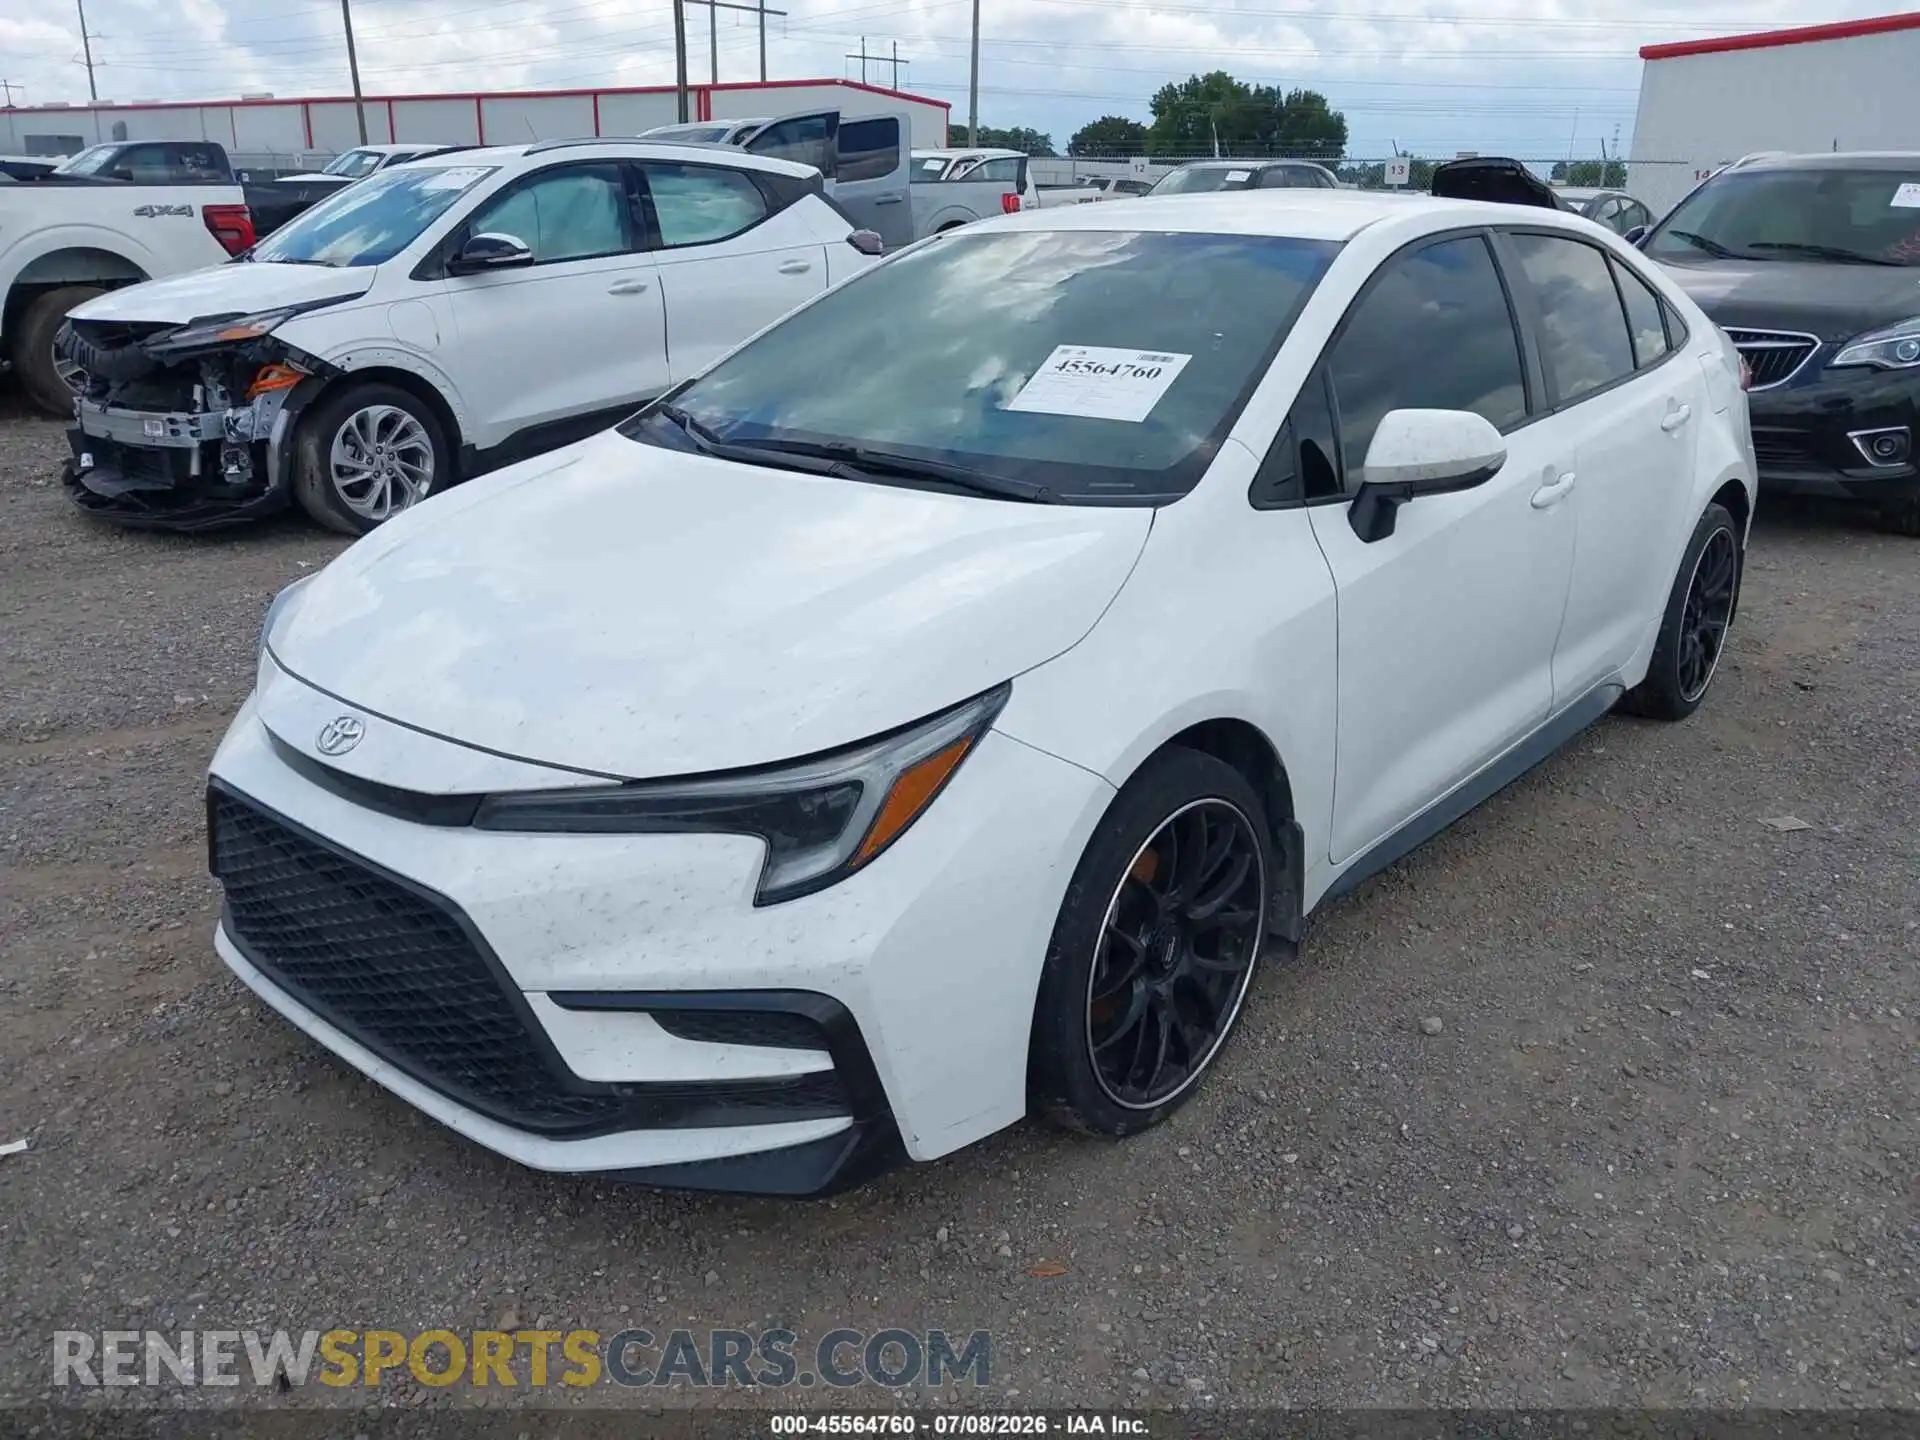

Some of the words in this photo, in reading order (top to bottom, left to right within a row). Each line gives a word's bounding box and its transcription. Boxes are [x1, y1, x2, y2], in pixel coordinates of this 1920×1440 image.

[1134, 164, 1145, 173] 12
[1391, 165, 1405, 175] 13
[1055, 360, 1162, 379] 45564760
